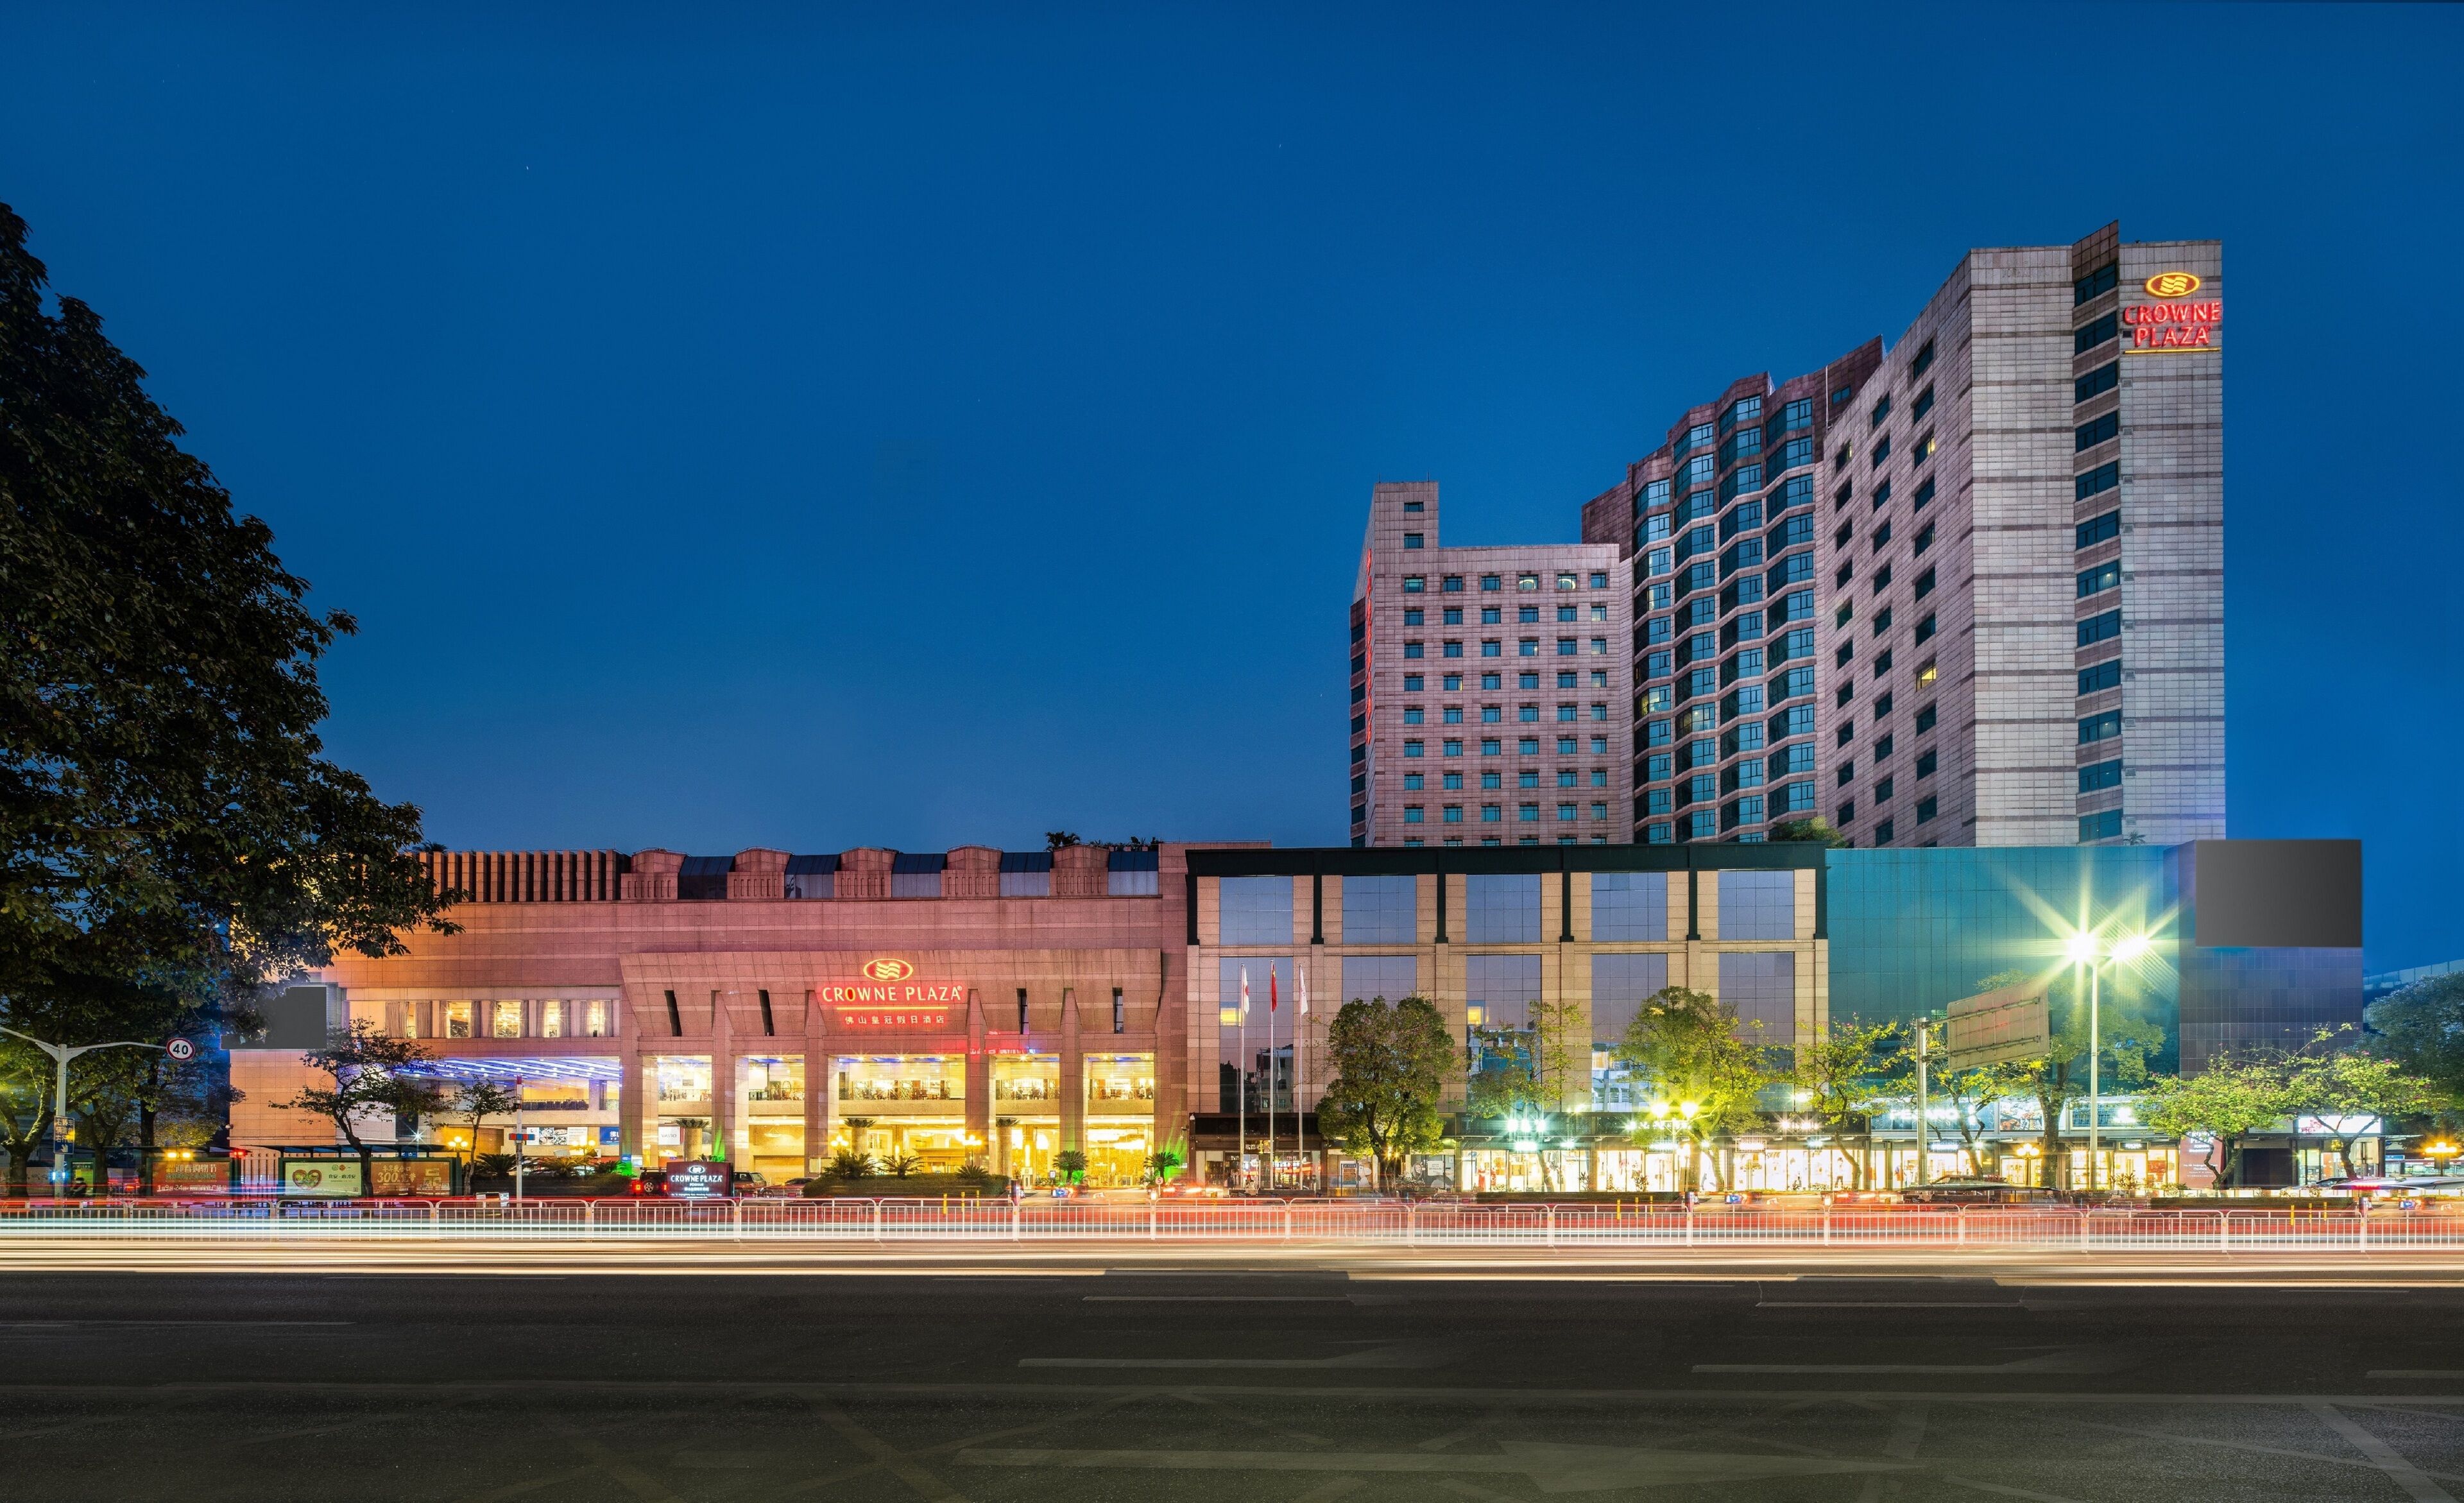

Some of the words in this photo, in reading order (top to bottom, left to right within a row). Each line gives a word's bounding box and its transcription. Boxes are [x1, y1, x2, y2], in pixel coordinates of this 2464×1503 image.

[2123, 302, 2222, 324] CROWNE
[823, 987, 898, 1002] CROWNE
[844, 1015, 945, 1025] 佛山皇冠假日酒店
[173, 1044, 189, 1055] 40
